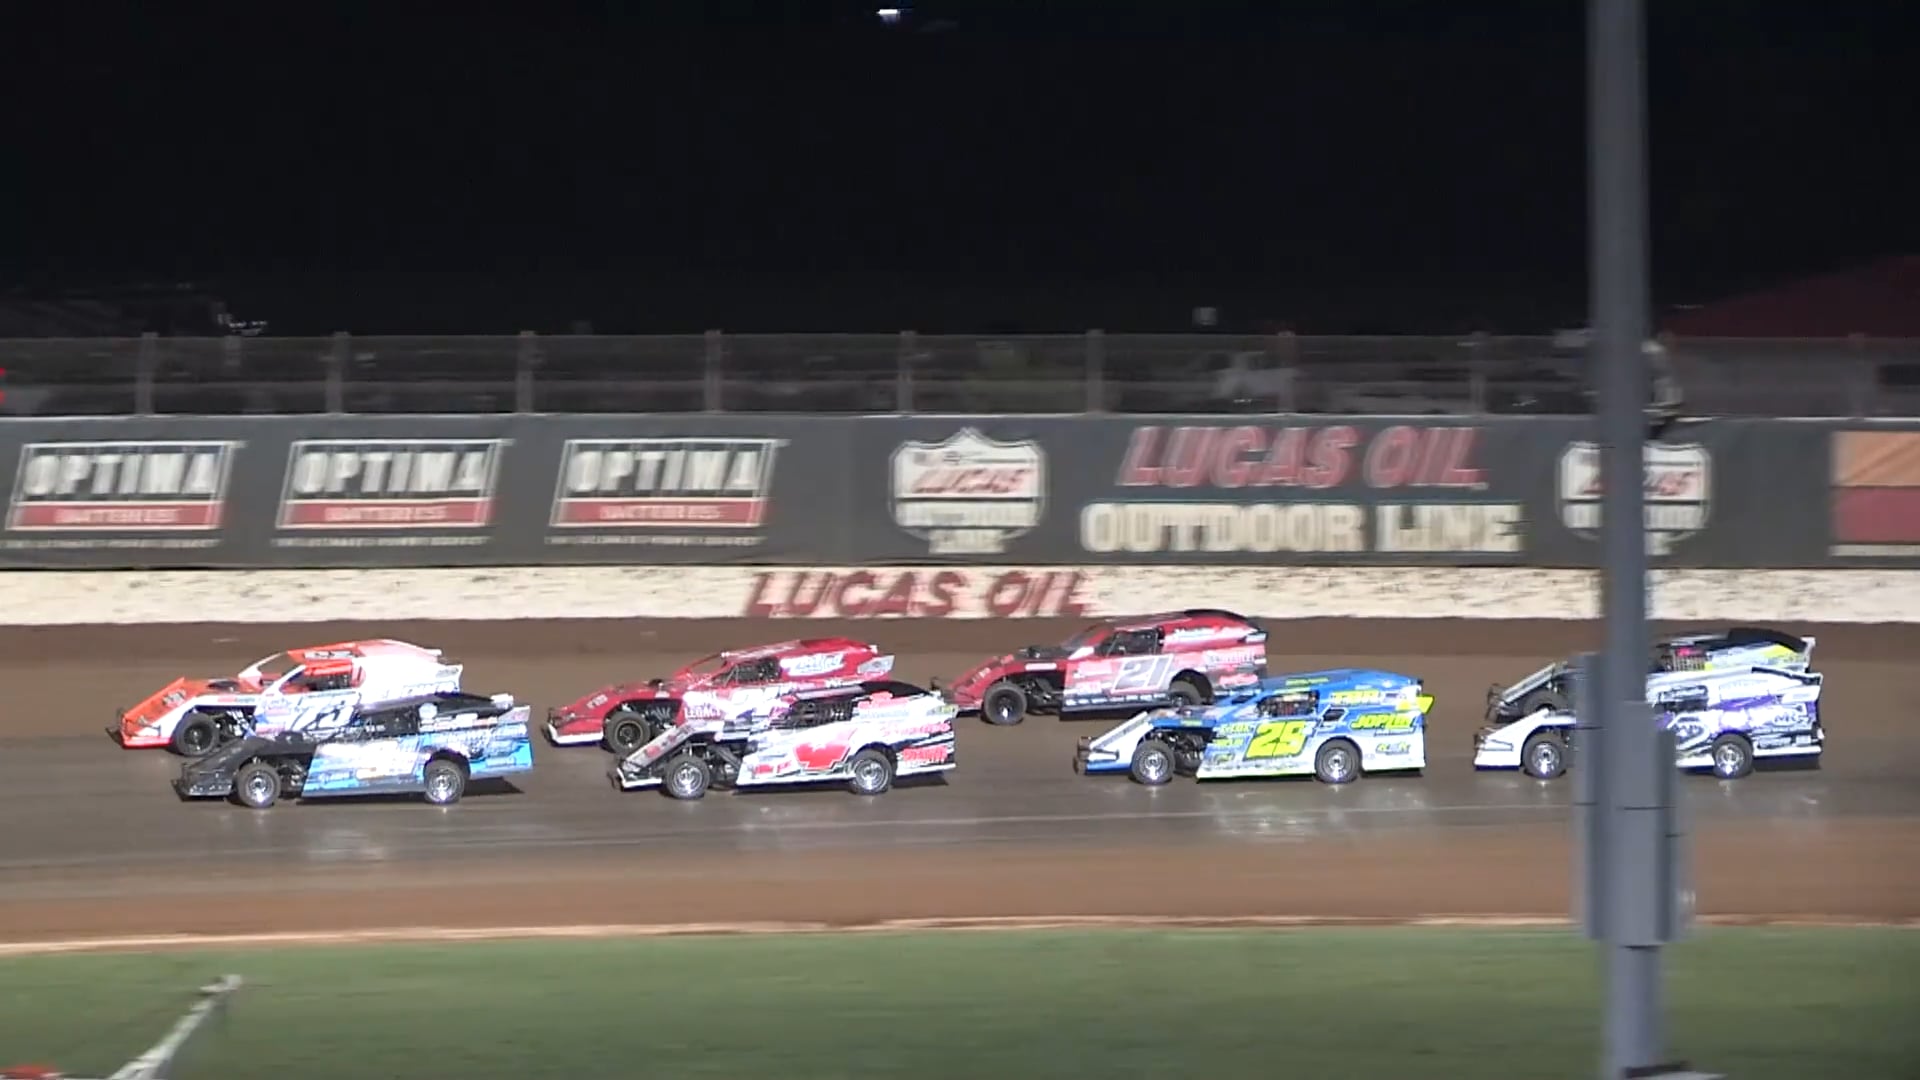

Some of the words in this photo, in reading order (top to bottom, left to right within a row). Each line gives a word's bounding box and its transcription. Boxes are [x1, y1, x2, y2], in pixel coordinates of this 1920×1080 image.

[23, 454, 219, 495] OPTIMA
[293, 452, 487, 493] OPTIMA
[566, 450, 760, 492] OPTIMA
[1115, 426, 1359, 488] LUCAS
[1364, 426, 1487, 489] OIL
[1081, 503, 1365, 552] OUTDOOR
[1375, 503, 1521, 552] LINE
[744, 571, 968, 617] LUCAS
[985, 570, 1090, 617] OIL
[1113, 654, 1174, 693] 21
